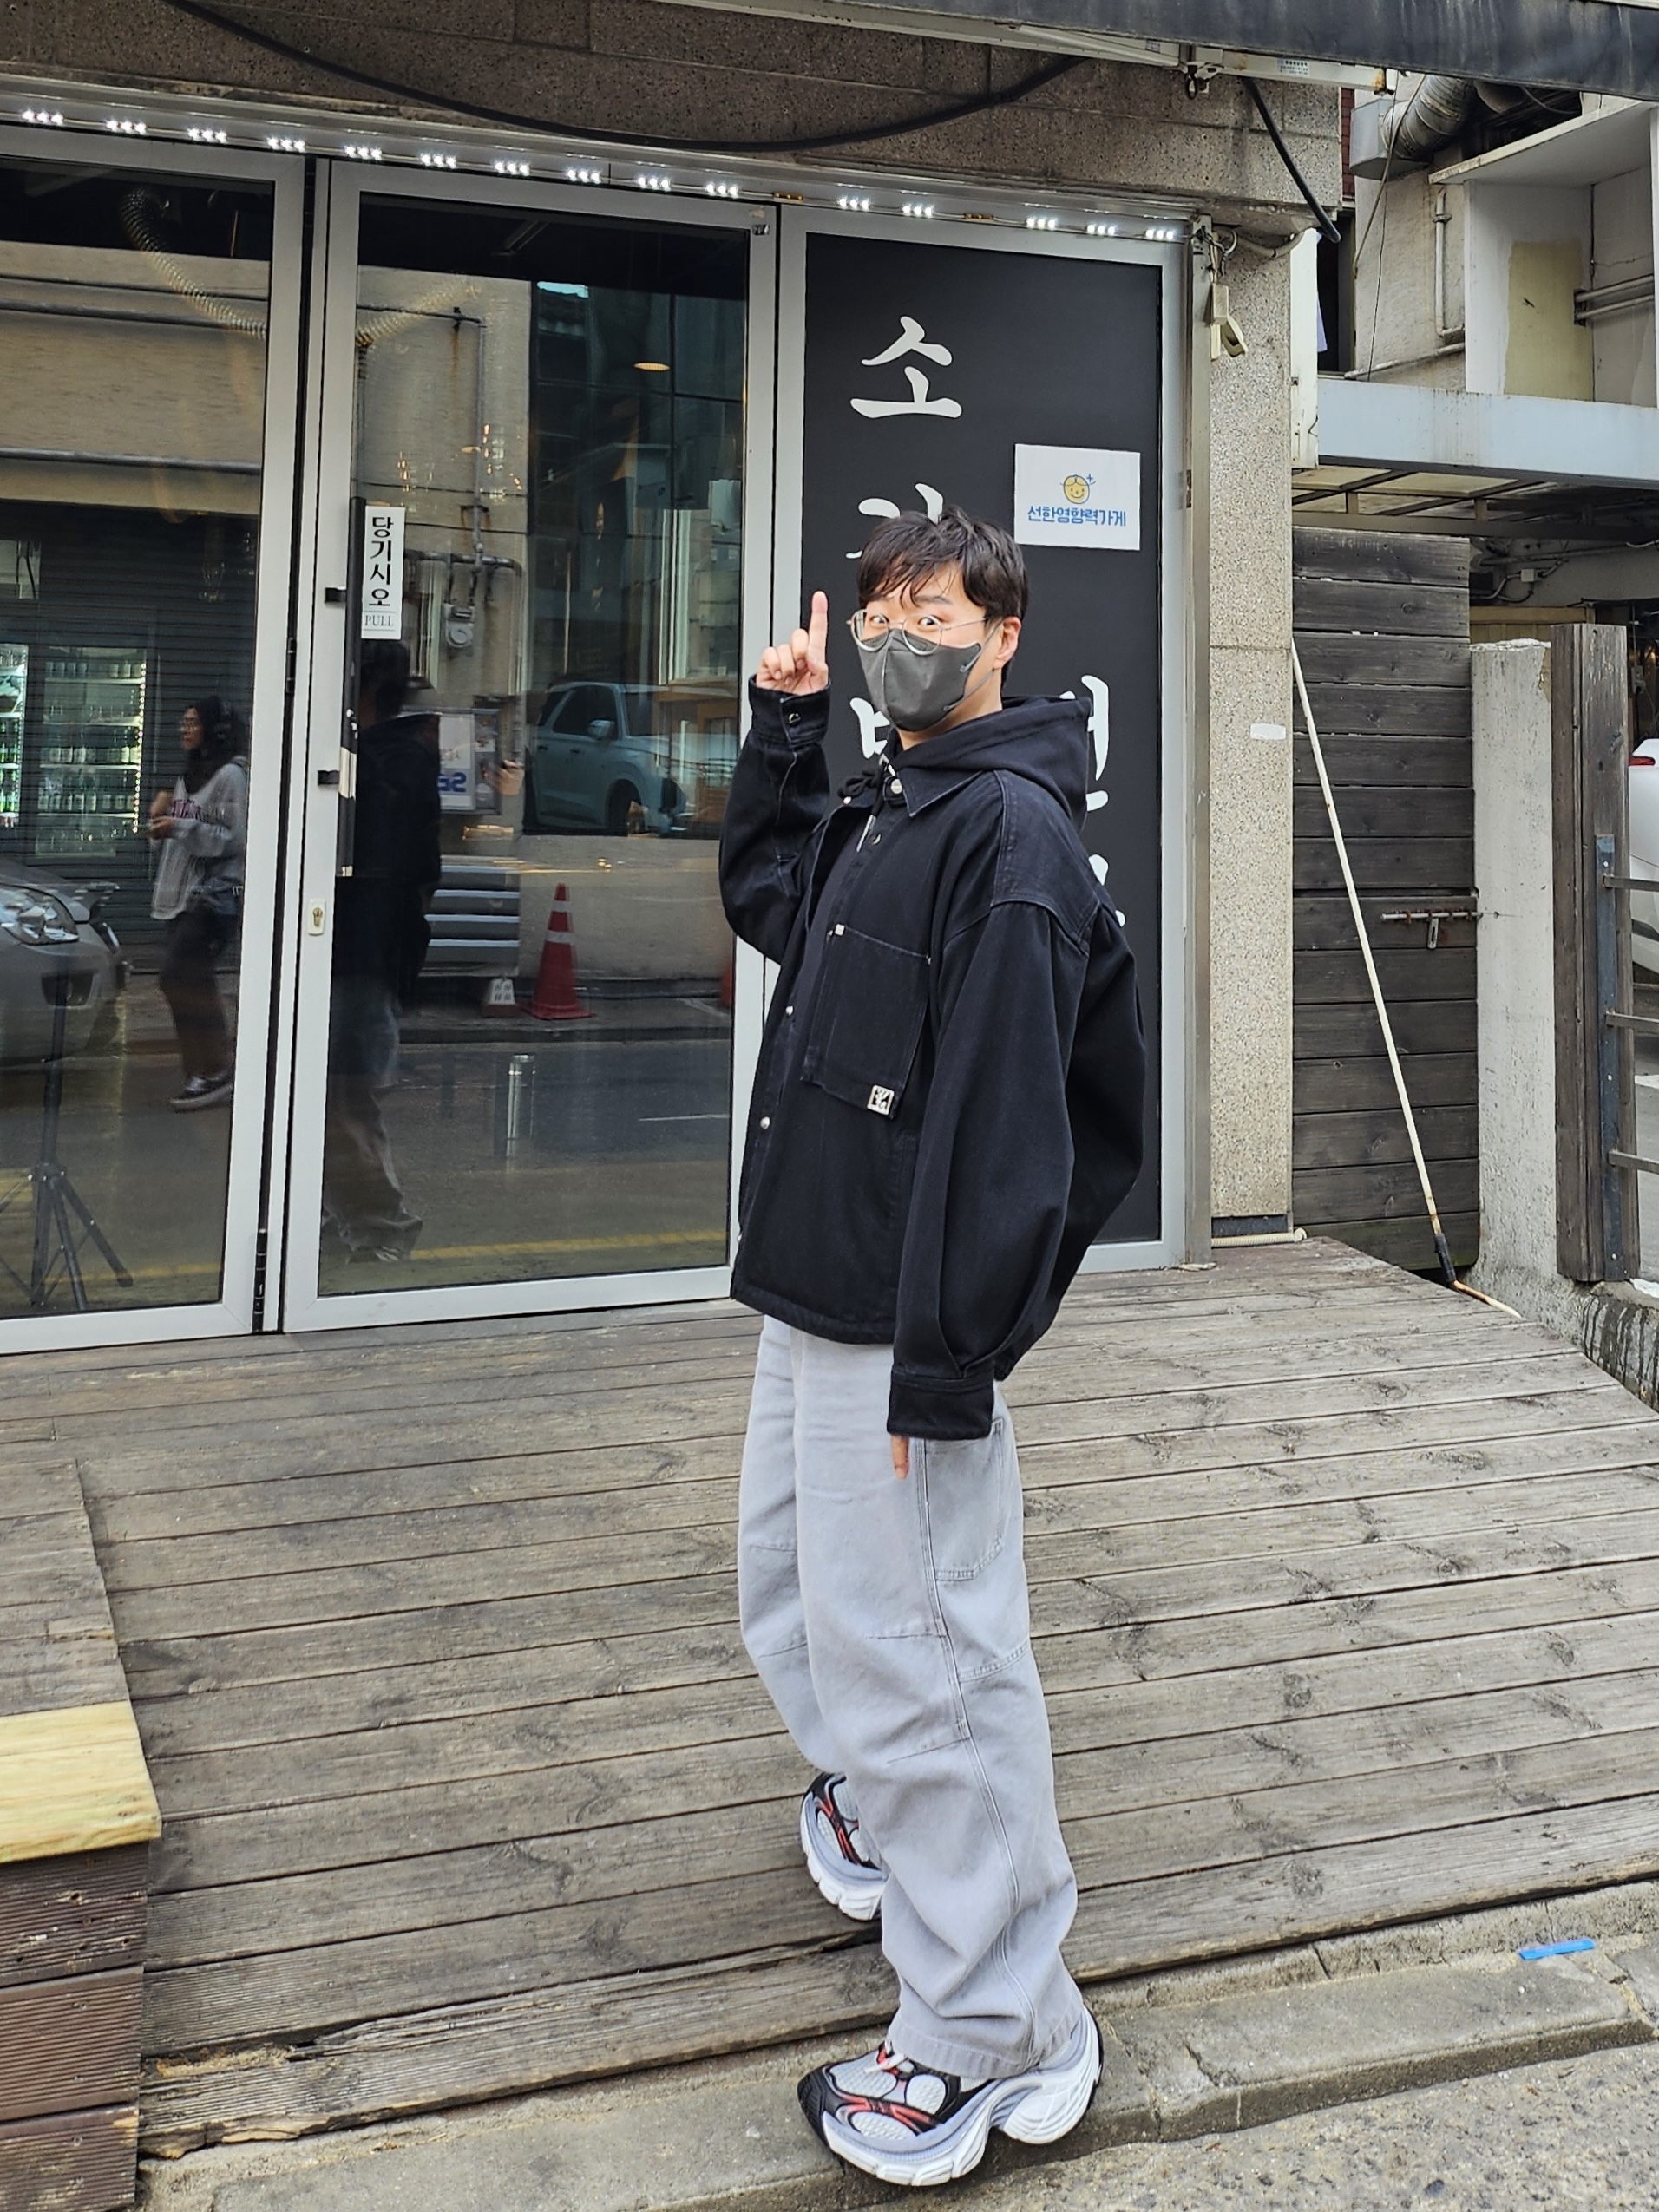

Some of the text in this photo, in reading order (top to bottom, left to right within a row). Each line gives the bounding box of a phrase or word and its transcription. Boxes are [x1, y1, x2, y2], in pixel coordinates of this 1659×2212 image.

[1027, 505, 1127, 527] 선한영향력가게
[368, 516, 395, 607] 당기시오
[364, 614, 395, 627] PULL
